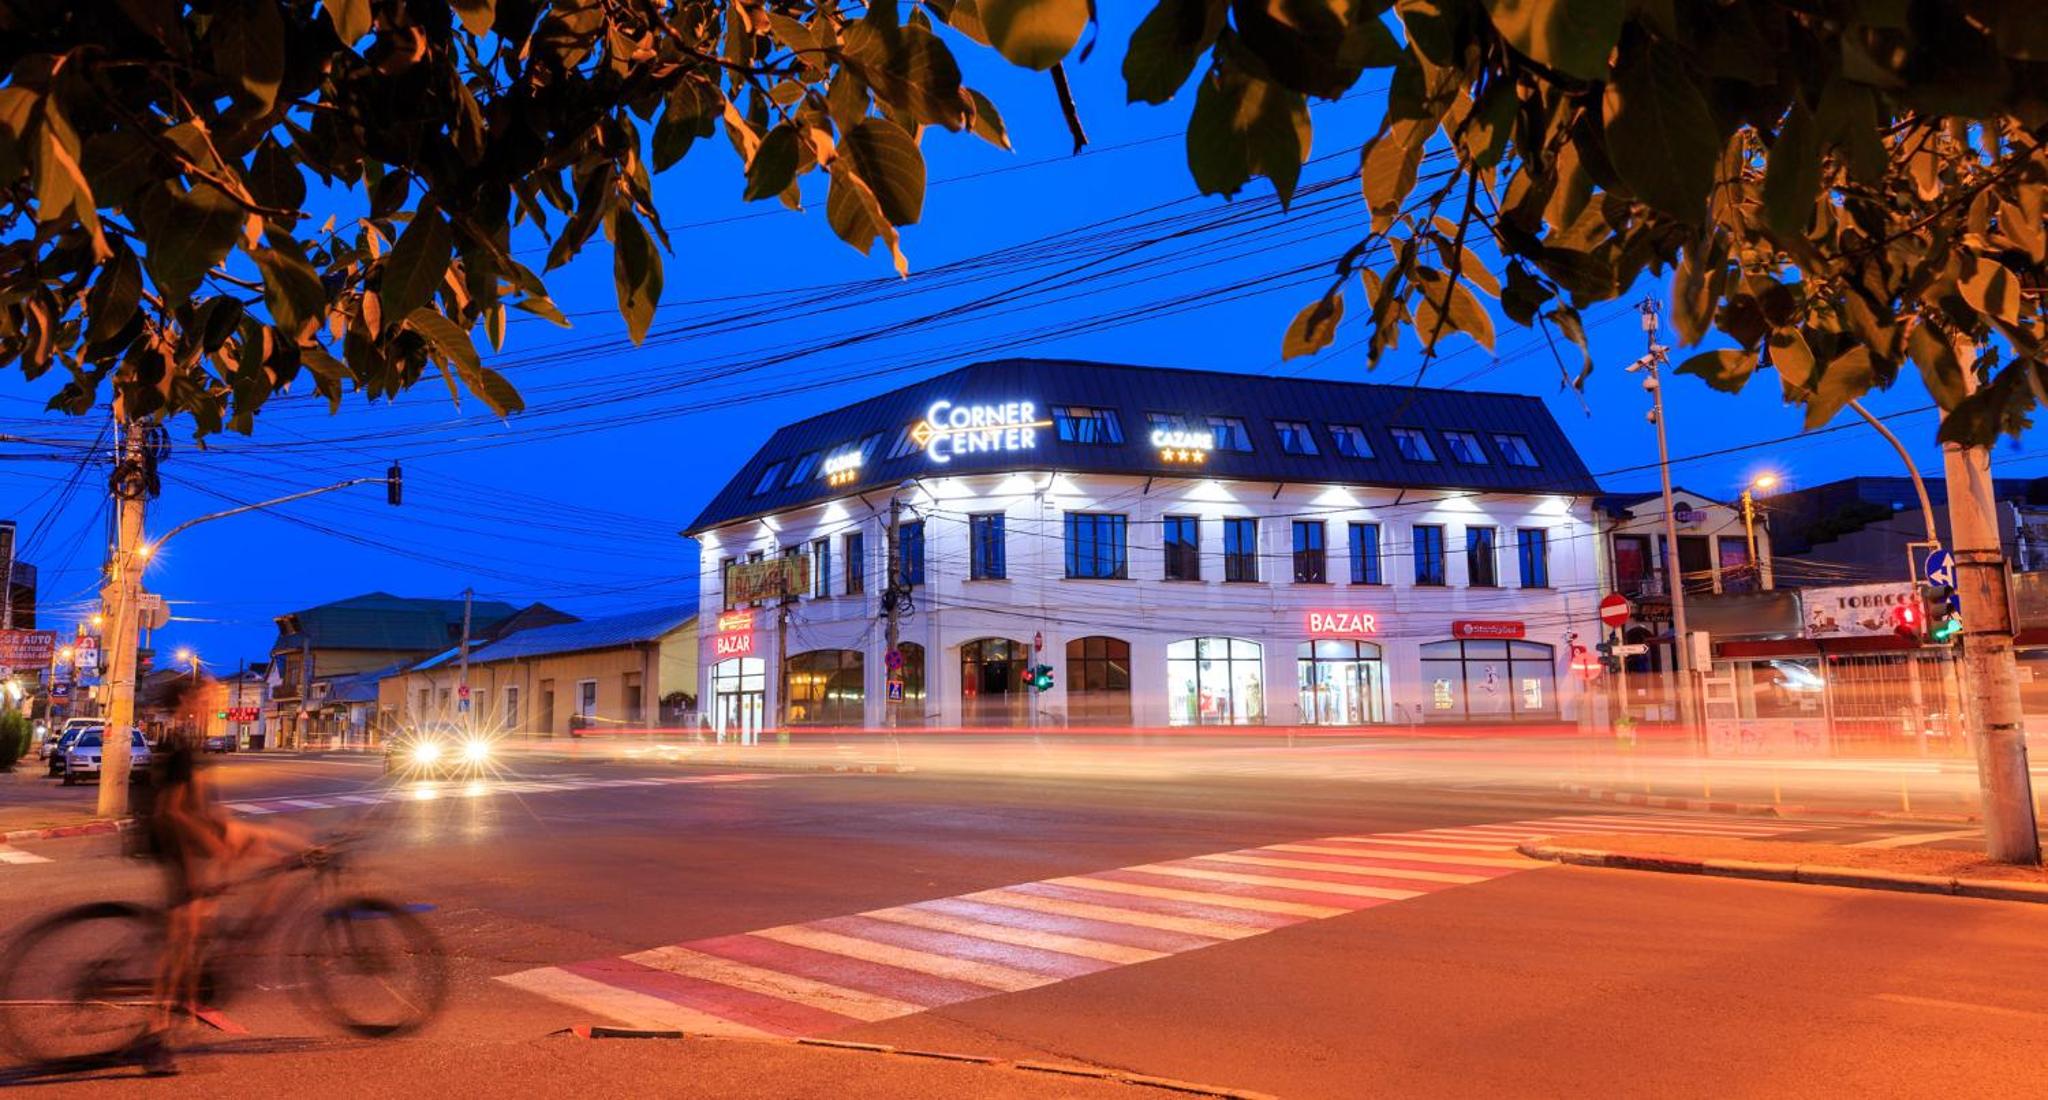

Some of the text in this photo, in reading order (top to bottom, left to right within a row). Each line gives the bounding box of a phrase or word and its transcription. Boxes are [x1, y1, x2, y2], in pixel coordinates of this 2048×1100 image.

[927, 400, 1035, 430] CORNER
[927, 428, 1036, 462] CENTER
[1310, 613, 1376, 633] BAZAR
[22, 635, 52, 645] AUTO
[717, 635, 751, 654] BAZAR
